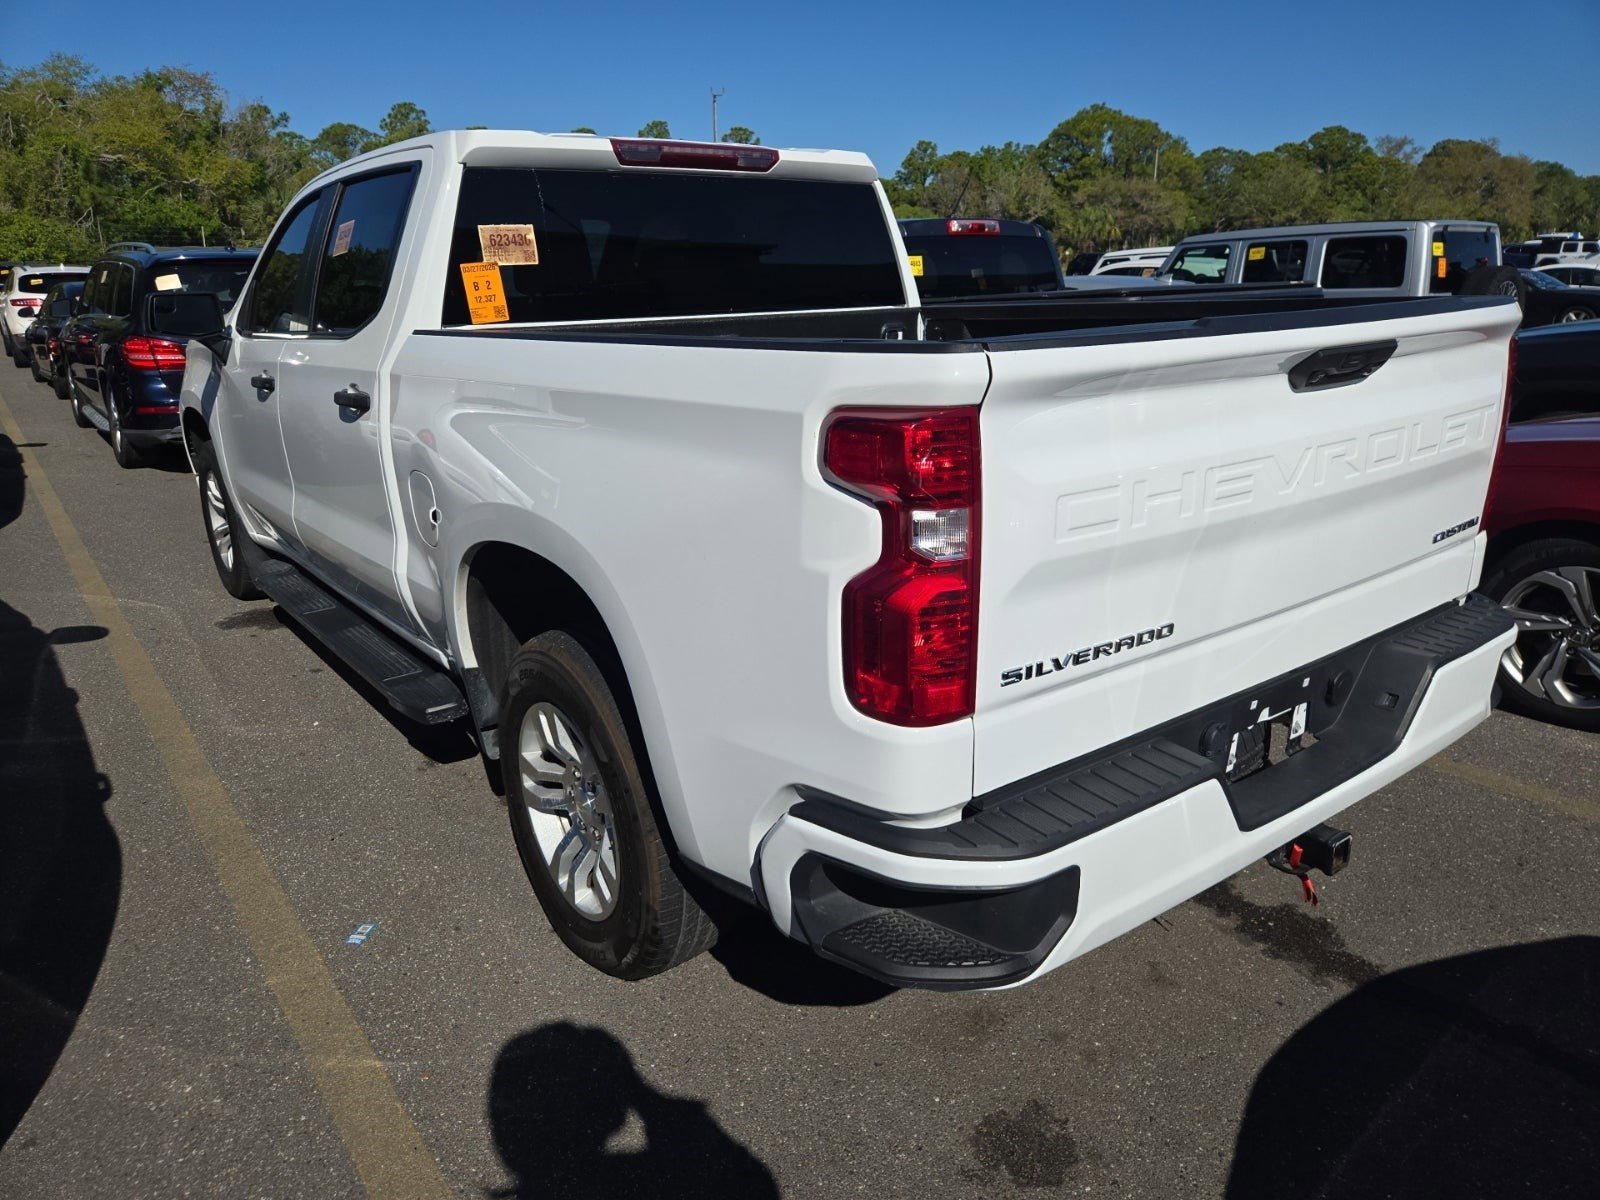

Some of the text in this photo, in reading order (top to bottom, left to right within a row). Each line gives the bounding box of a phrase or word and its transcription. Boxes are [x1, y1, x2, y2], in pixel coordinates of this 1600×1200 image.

[473, 280, 492, 291] B 2
[1055, 403, 1496, 544] CHEVROLET
[1432, 516, 1480, 544] CUSTOM
[1000, 622, 1175, 688] SILVERADO
